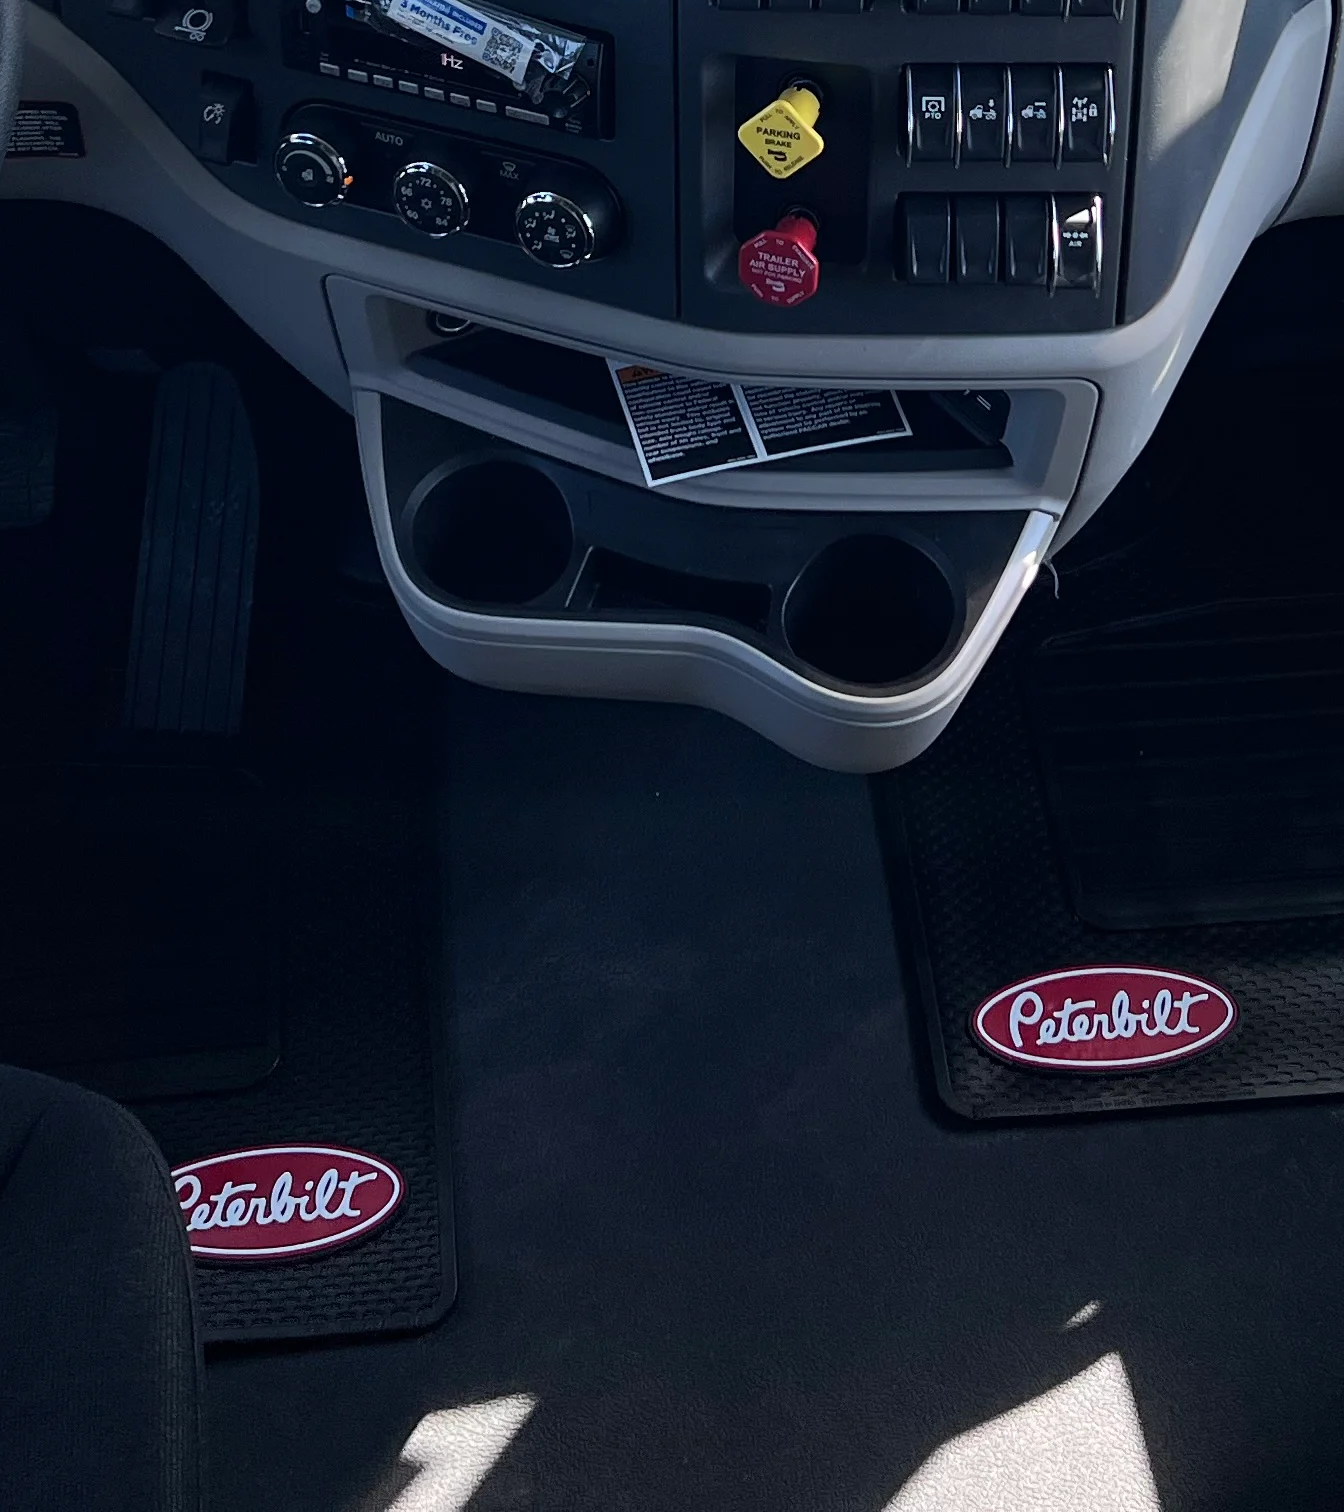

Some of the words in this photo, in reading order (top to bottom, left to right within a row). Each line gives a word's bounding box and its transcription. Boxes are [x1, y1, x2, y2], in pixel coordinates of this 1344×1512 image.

[409, 3, 451, 32] Months
[452, 23, 478, 45] Free
[924, 112, 941, 120] PTO
[374, 131, 404, 146] AUTO
[756, 126, 801, 141] PARKING
[764, 138, 792, 148] BRAKE
[419, 176, 433, 189] 72
[499, 169, 520, 181] MAX
[439, 196, 453, 208] 78
[1068, 240, 1083, 248] AIR
[757, 251, 799, 268] TRAILER
[749, 259, 766, 270] AIR
[767, 263, 806, 278] SUPPLY
[1009, 988, 1210, 1048] Peterbilt
[174, 1167, 378, 1232] Peterbilt
